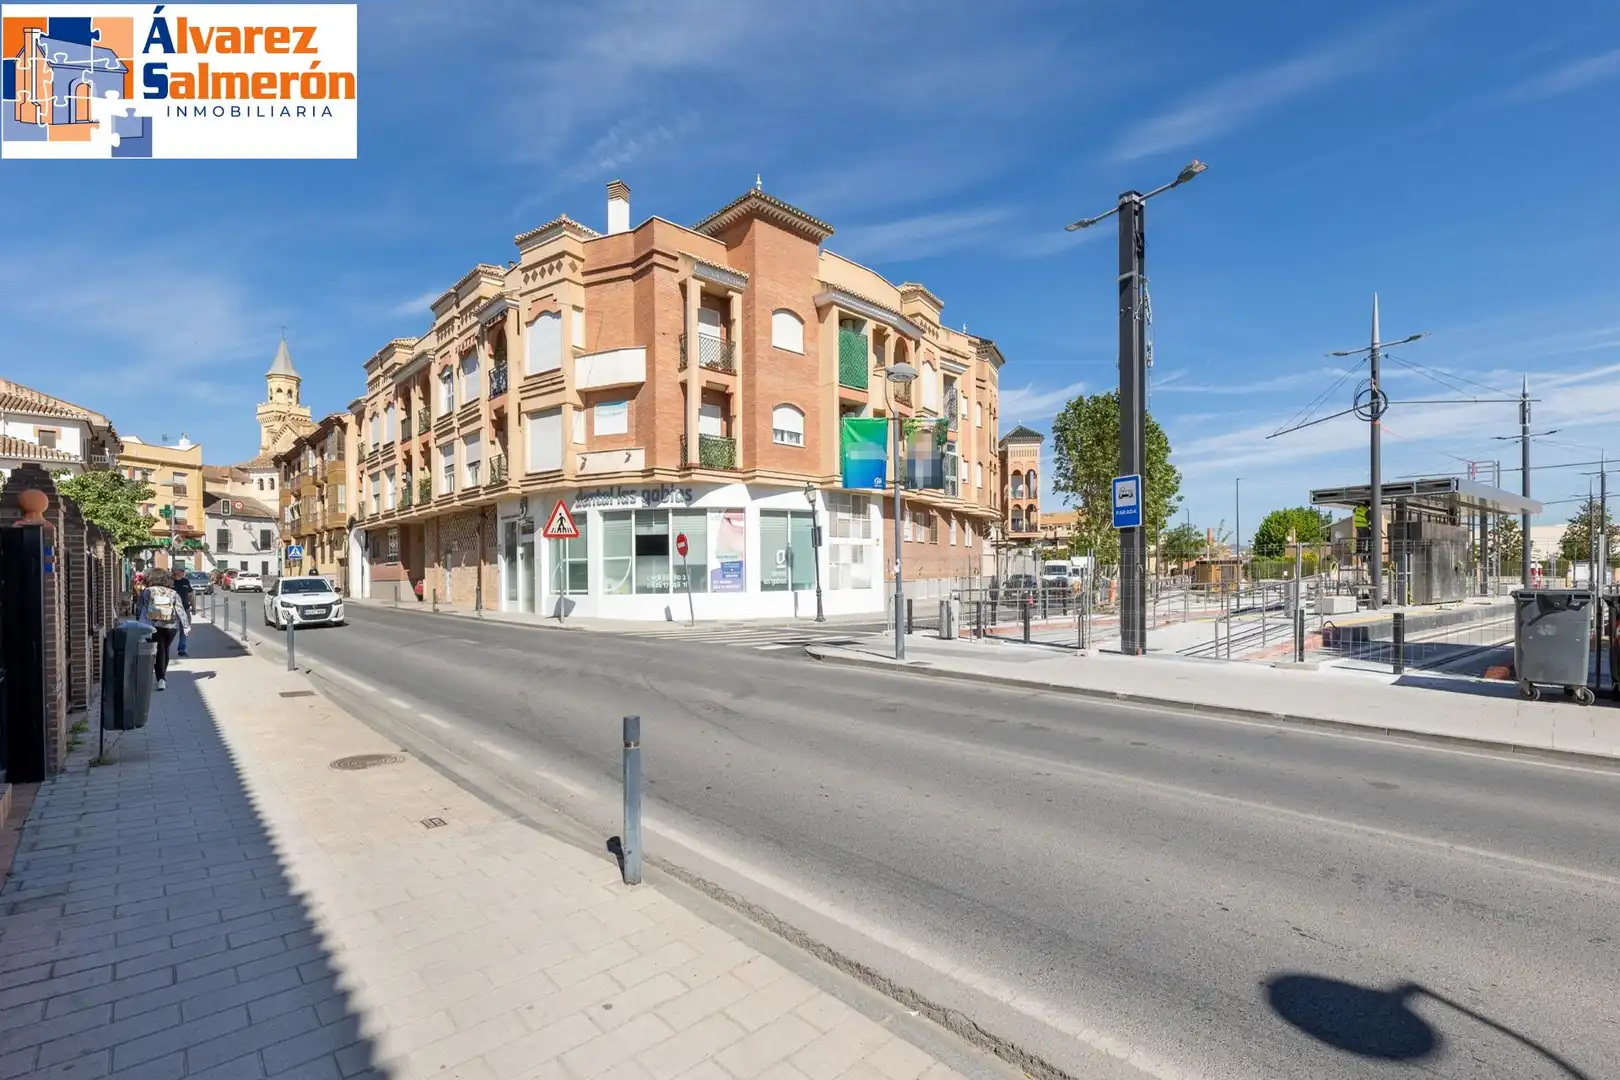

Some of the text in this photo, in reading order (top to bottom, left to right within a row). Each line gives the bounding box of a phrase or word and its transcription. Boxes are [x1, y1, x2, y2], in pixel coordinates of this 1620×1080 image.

[575, 483, 693, 508] dental las gabias
